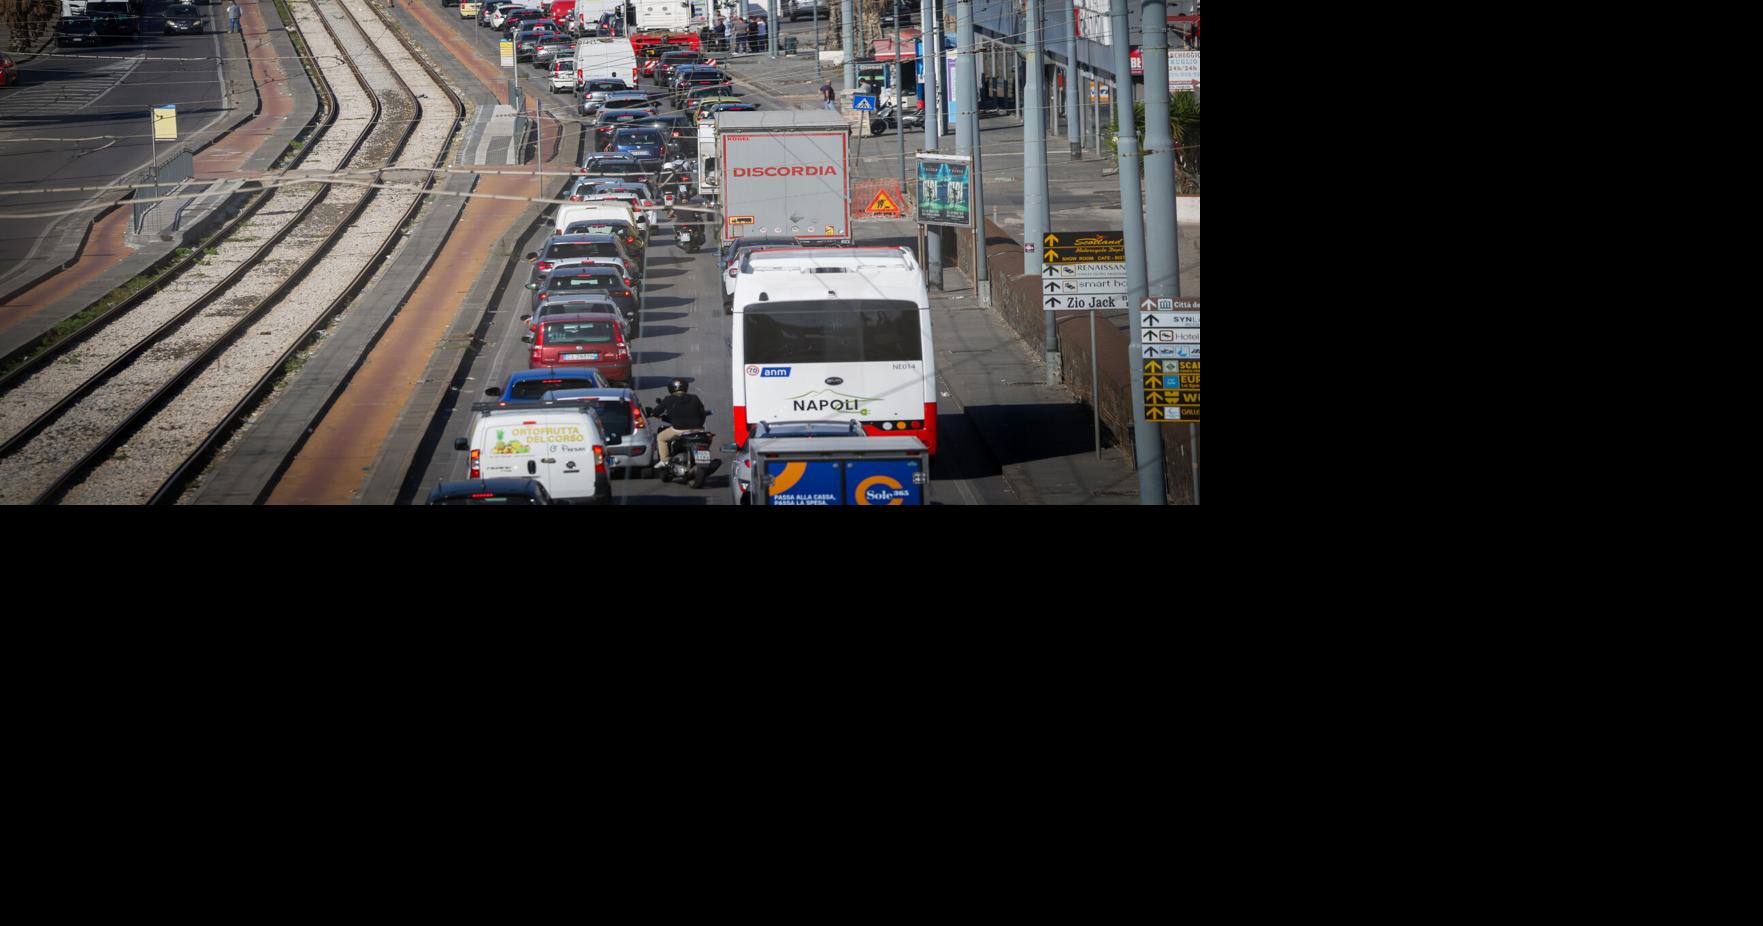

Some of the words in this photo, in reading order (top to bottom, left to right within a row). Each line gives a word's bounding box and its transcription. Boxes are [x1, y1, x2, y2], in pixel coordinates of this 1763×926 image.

[733, 165, 837, 177] DISCORDIA
[1067, 297, 1085, 308] Zio
[1088, 296, 1115, 308] Jack
[764, 369, 787, 377] anm
[793, 399, 859, 411] NAPOLI
[512, 426, 579, 436] ORTOFRUTTA
[526, 435, 545, 443] DEL
[546, 434, 584, 442] CORSO
